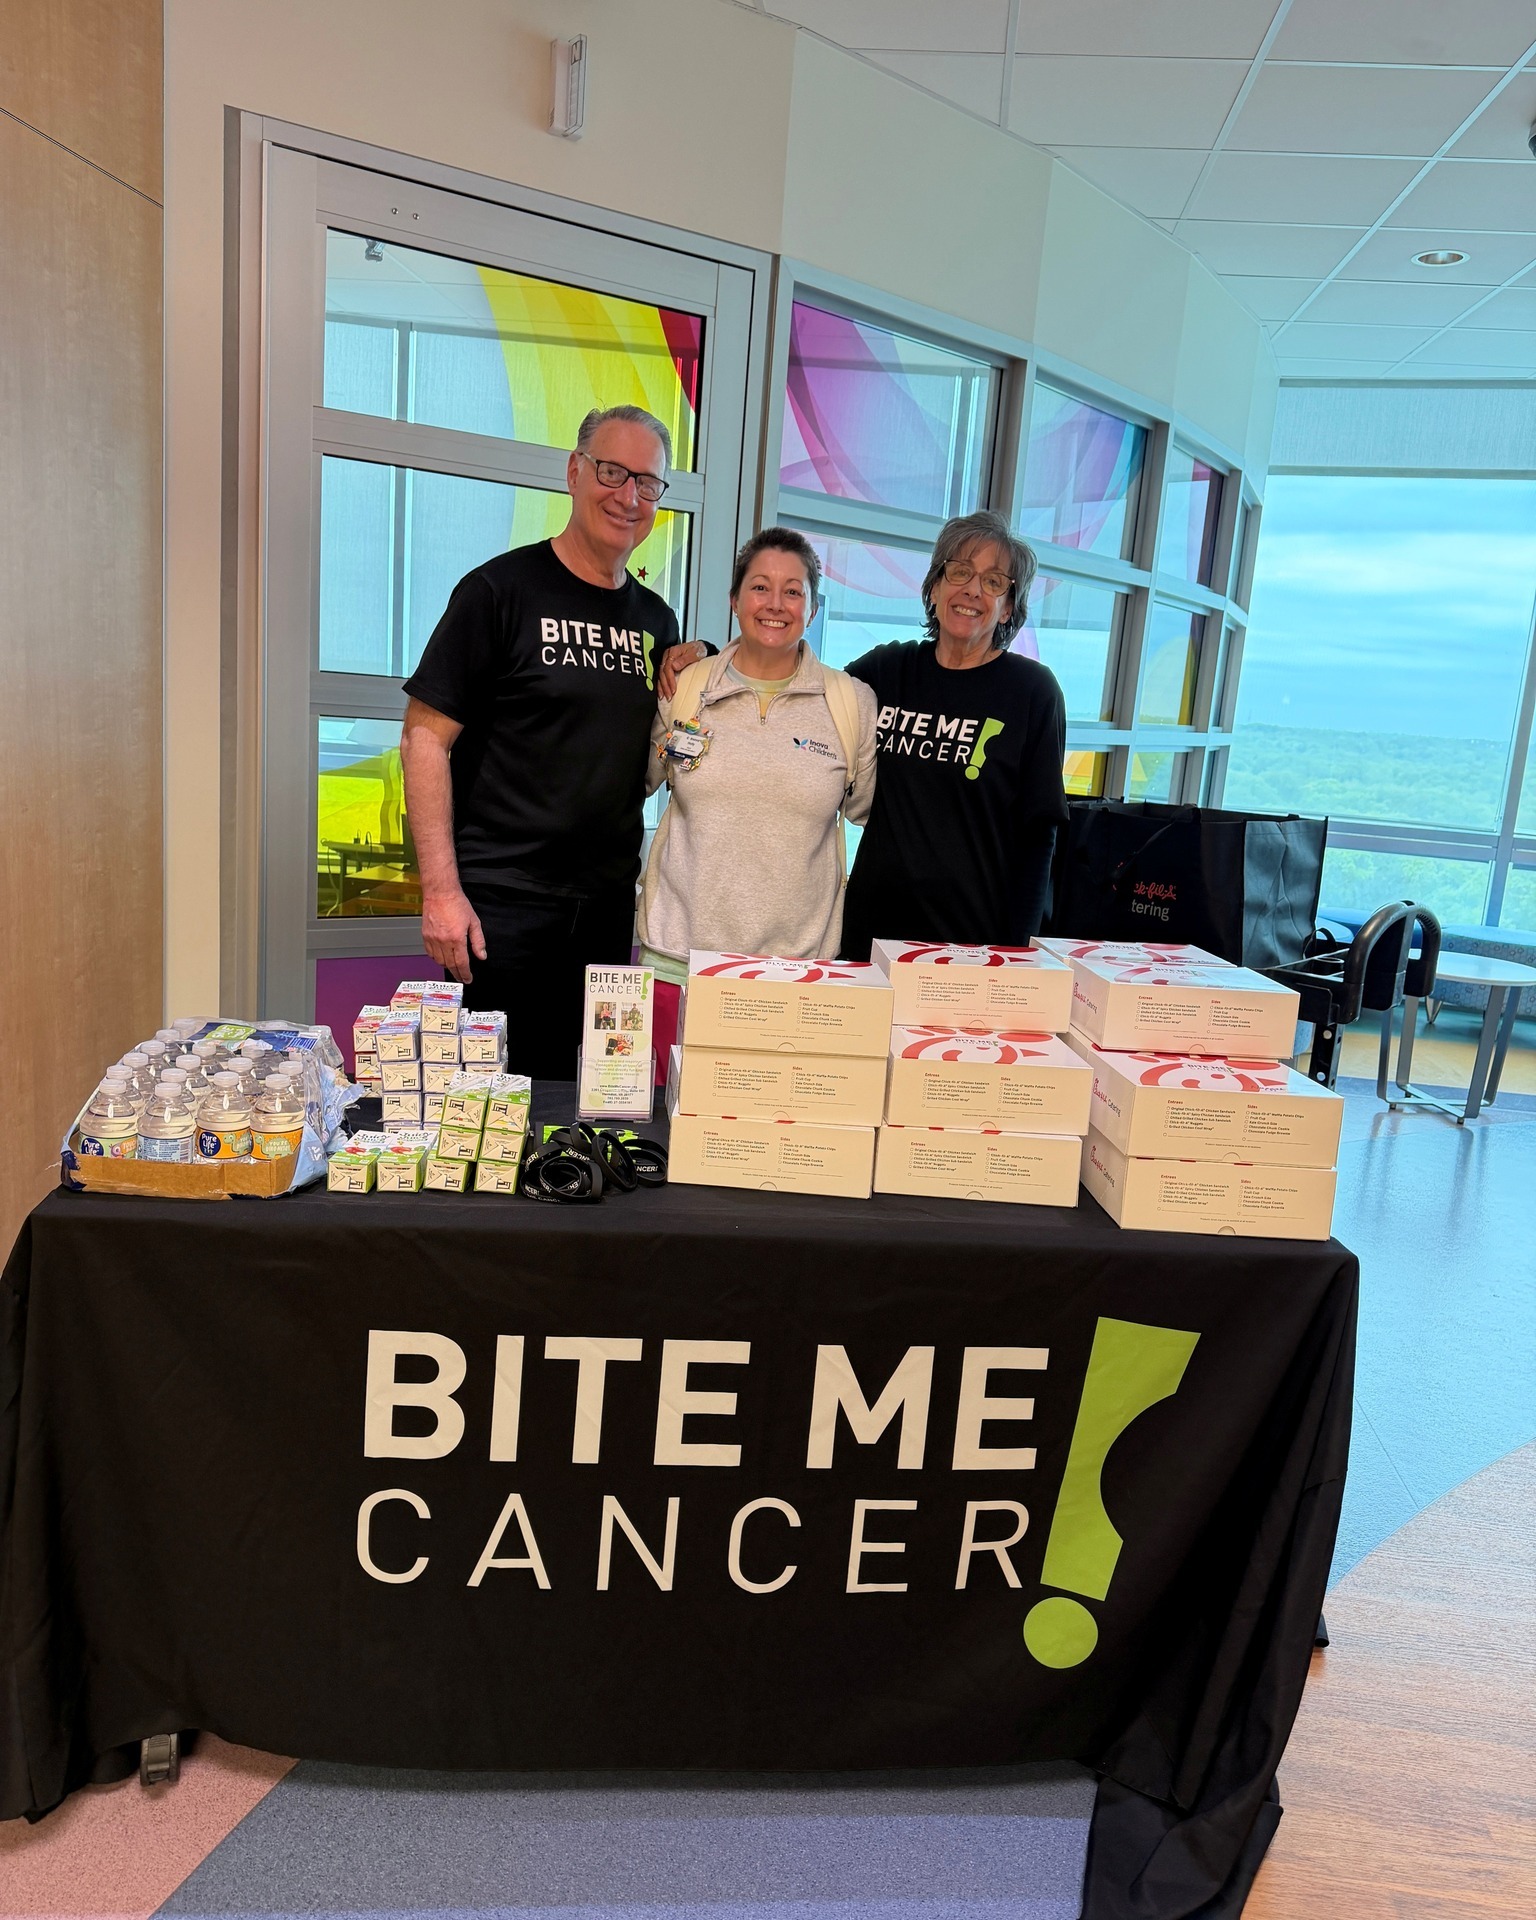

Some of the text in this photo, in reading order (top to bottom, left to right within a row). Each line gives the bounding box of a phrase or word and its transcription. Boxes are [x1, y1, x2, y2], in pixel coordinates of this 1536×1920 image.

[540, 617, 604, 648] BITE
[609, 626, 642, 655] ME
[877, 705, 933, 736] BITE
[935, 714, 979, 743] ME
[810, 739, 828, 750] Inova
[590, 972, 619, 984] BITE
[623, 973, 642, 984] ME
[202, 1133, 218, 1143] Pure
[84, 1139, 100, 1150] Pure
[202, 1140, 215, 1150] Life
[364, 1330, 751, 1466] BITE
[806, 1345, 1049, 1470] ME
